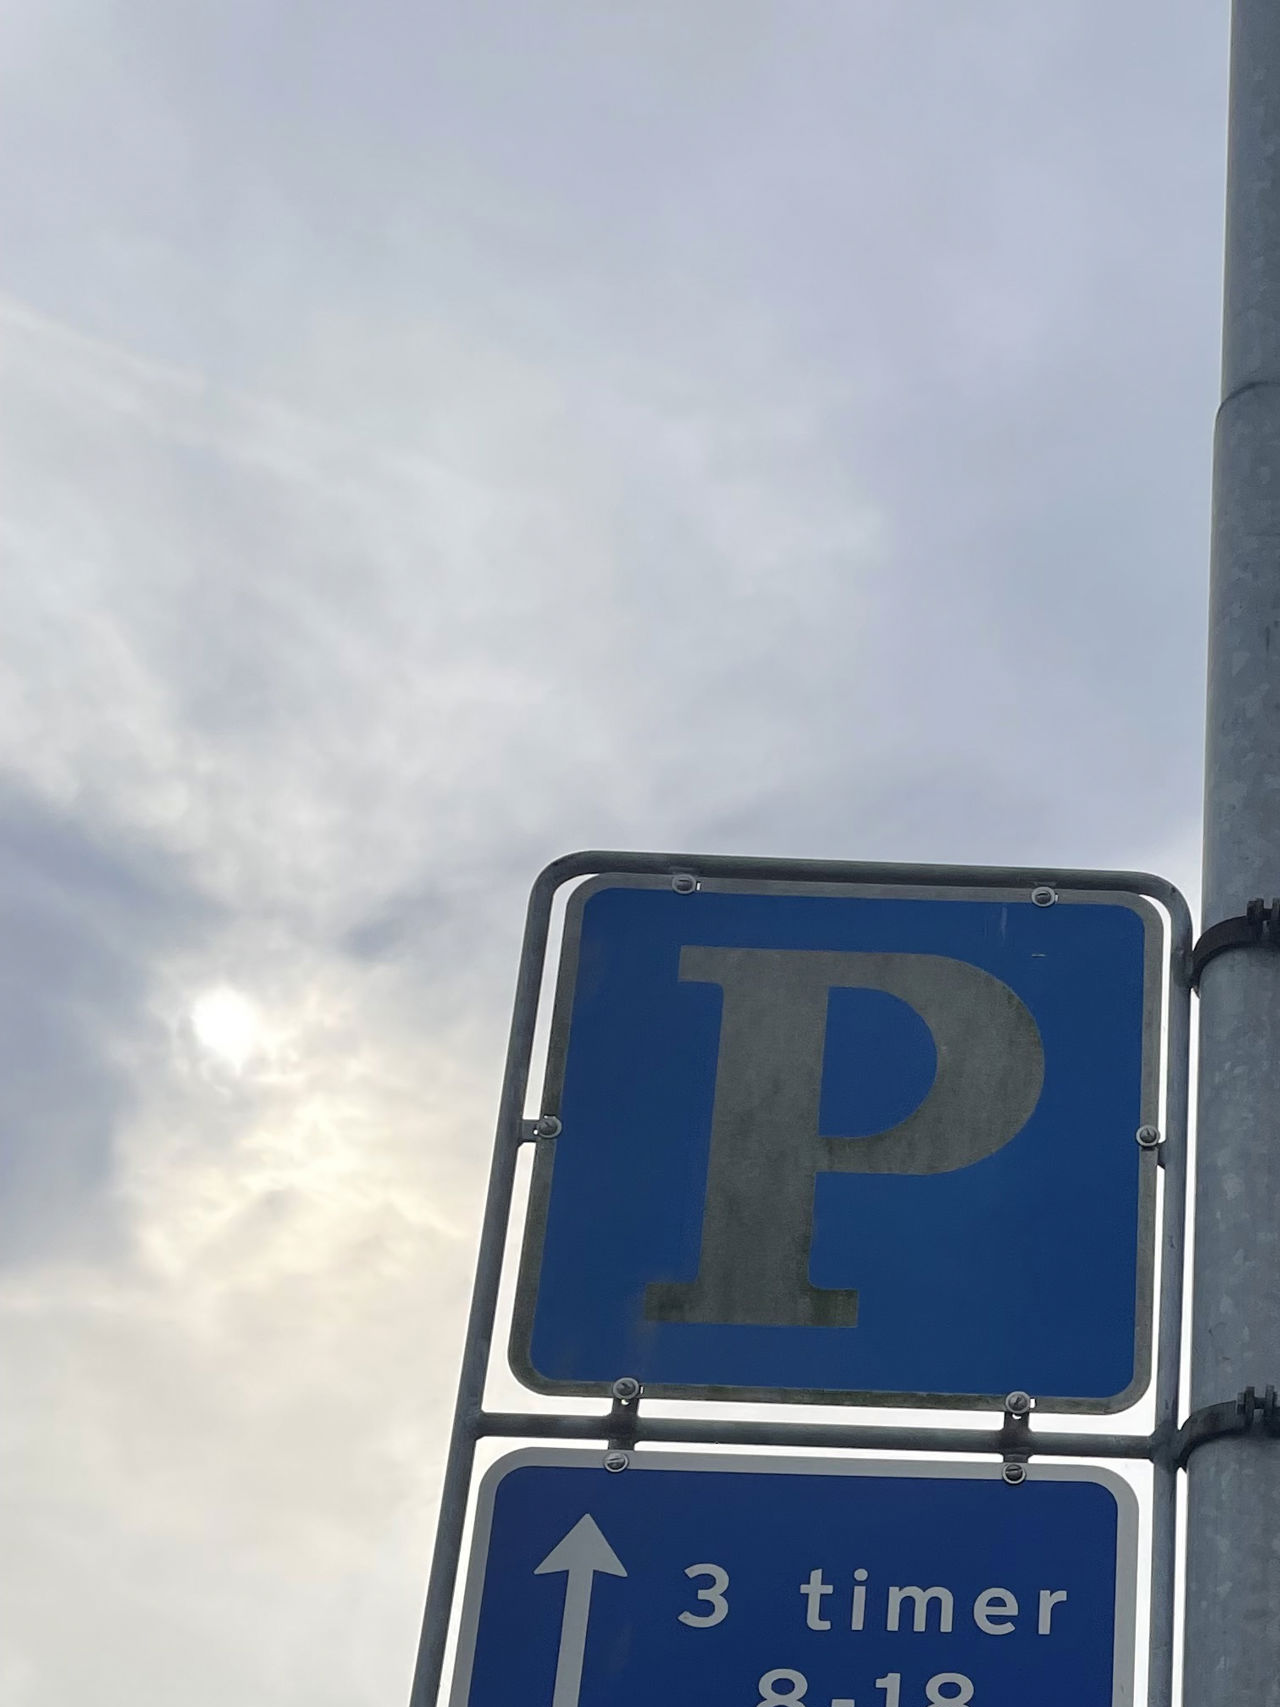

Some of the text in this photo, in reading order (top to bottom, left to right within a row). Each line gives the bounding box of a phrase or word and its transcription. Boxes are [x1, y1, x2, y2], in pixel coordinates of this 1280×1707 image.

[643, 945, 1046, 1329] P
[677, 1563, 1068, 1635] 3 timer
